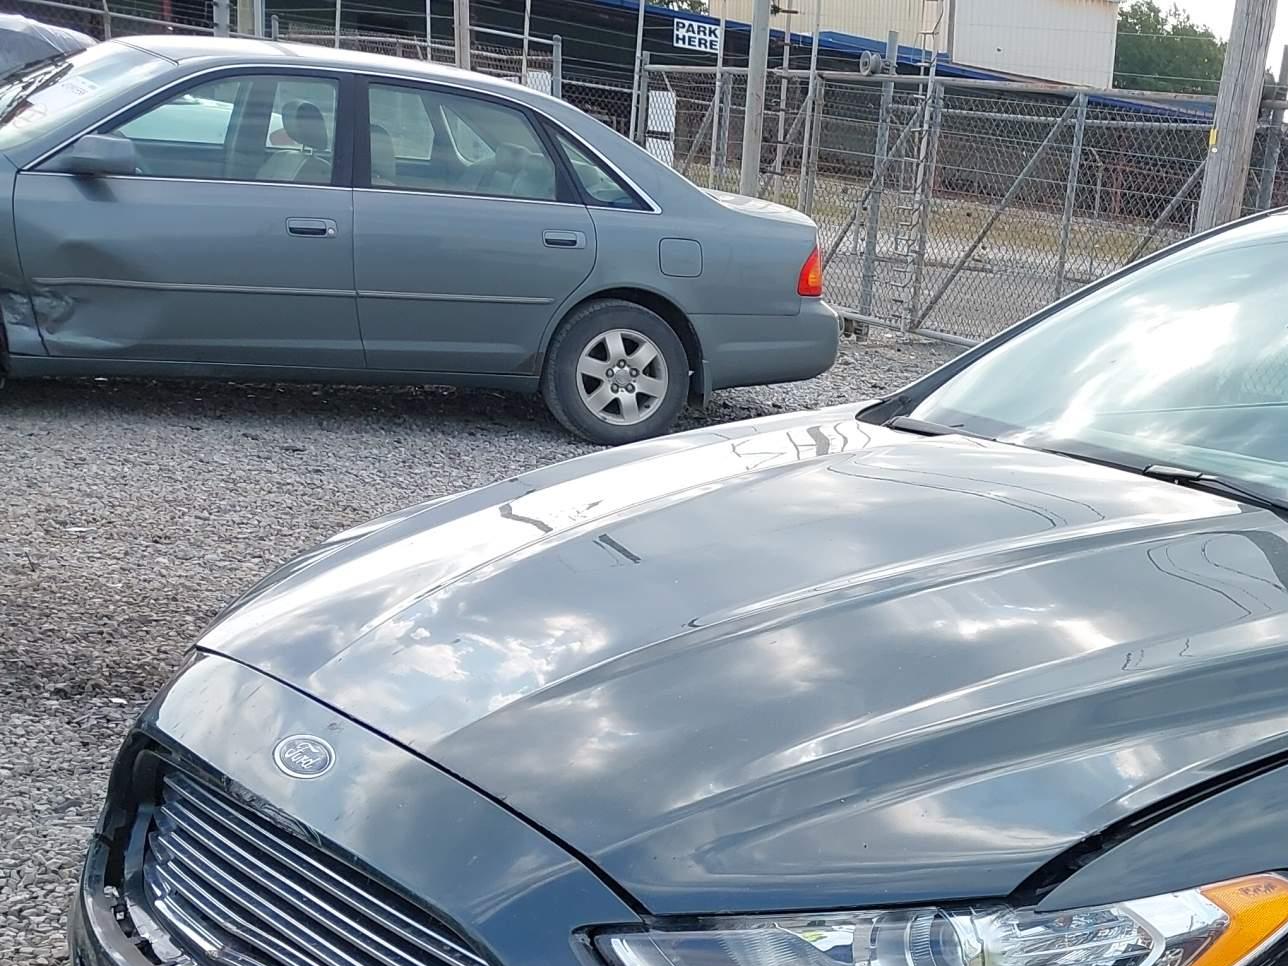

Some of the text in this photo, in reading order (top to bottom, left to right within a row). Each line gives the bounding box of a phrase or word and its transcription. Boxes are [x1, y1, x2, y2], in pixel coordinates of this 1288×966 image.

[676, 20, 719, 39] PARK
[675, 33, 719, 51] HERE
[285, 742, 321, 769] Ford
